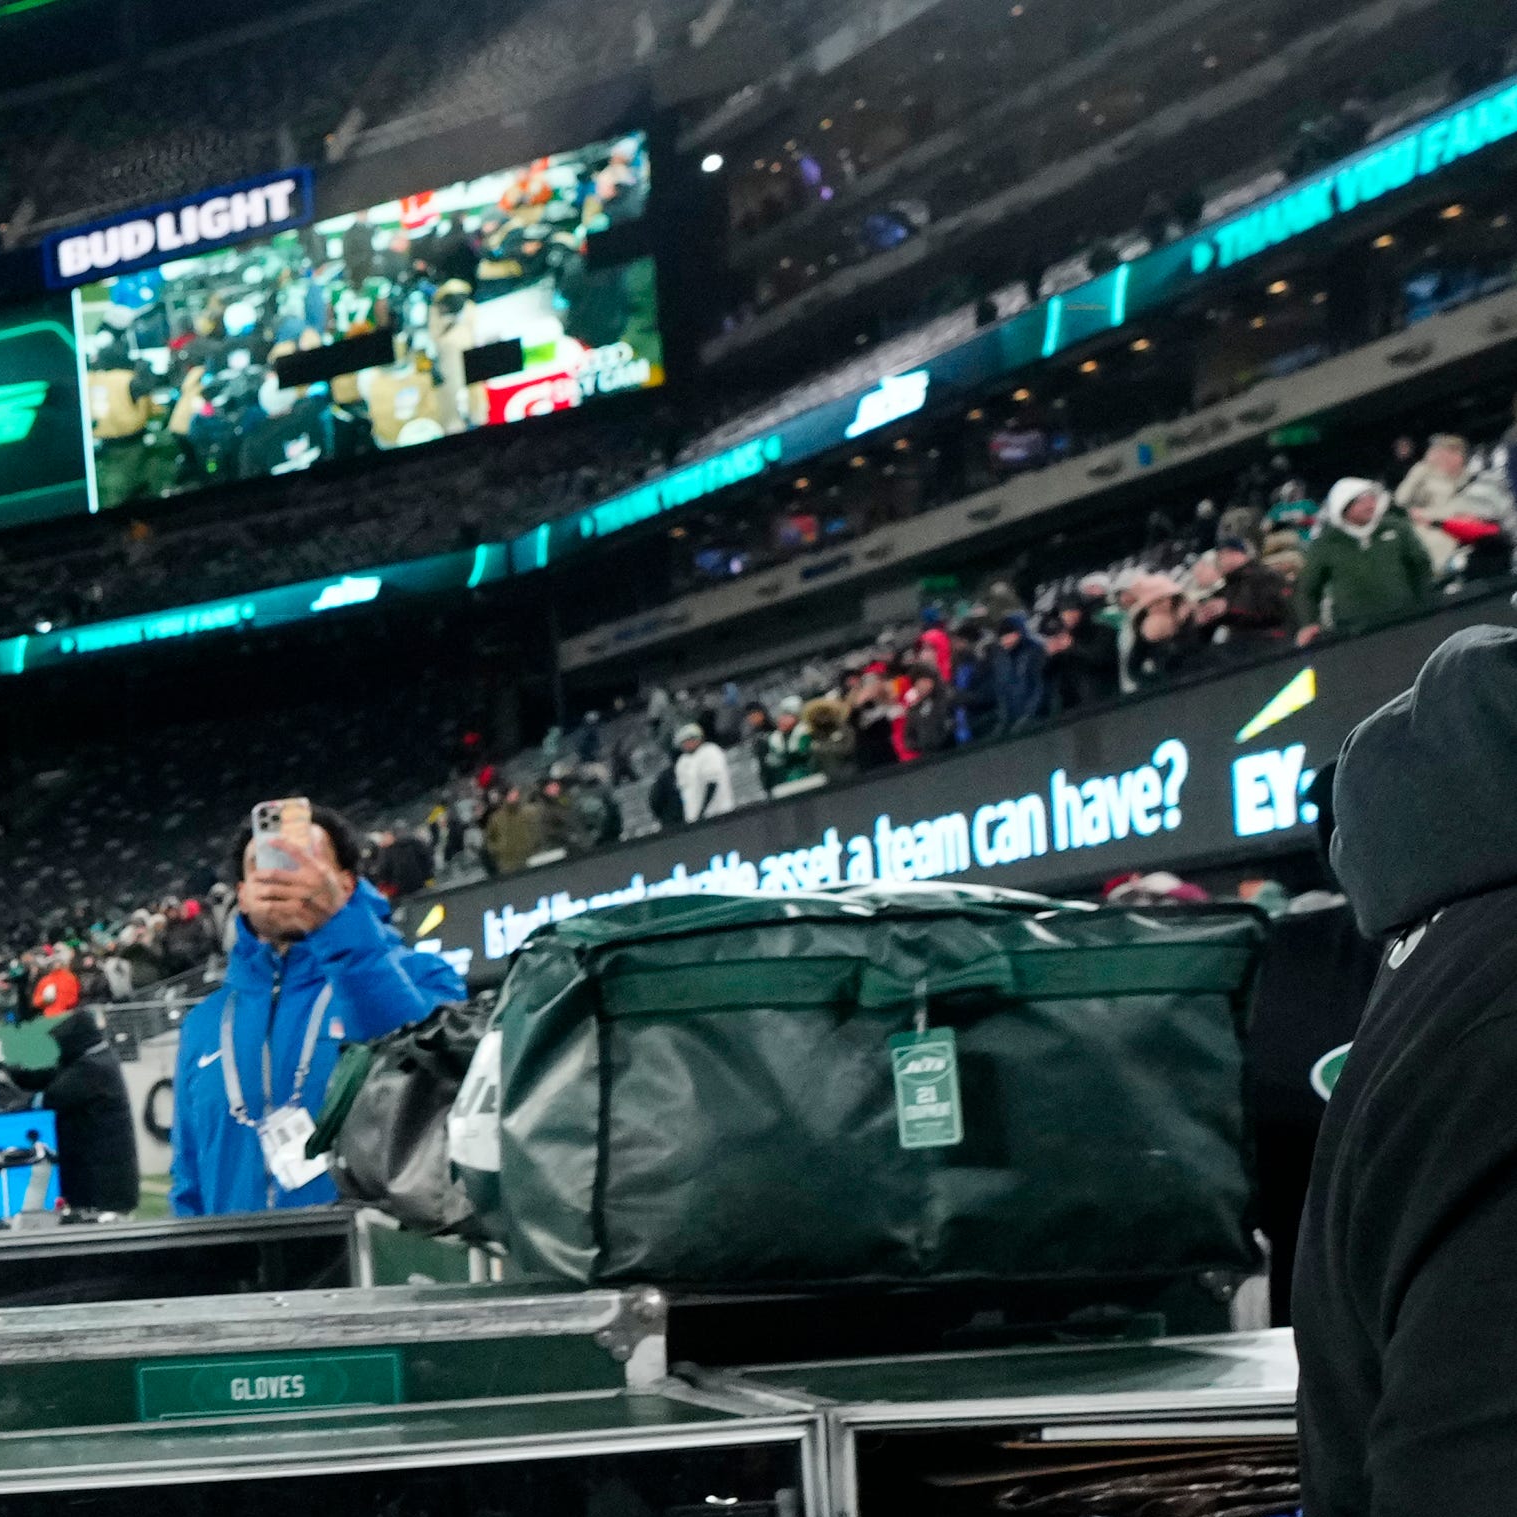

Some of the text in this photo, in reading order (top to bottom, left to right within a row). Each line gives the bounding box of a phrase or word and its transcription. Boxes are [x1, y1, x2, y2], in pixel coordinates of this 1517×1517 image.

[58, 178, 295, 277] BUD LIGHT
[759, 826, 842, 892] asset
[847, 836, 872, 885] a
[875, 812, 969, 883] team
[973, 793, 1047, 866] can
[1050, 739, 1189, 851] have?
[230, 1375, 305, 1401] GLOVES
